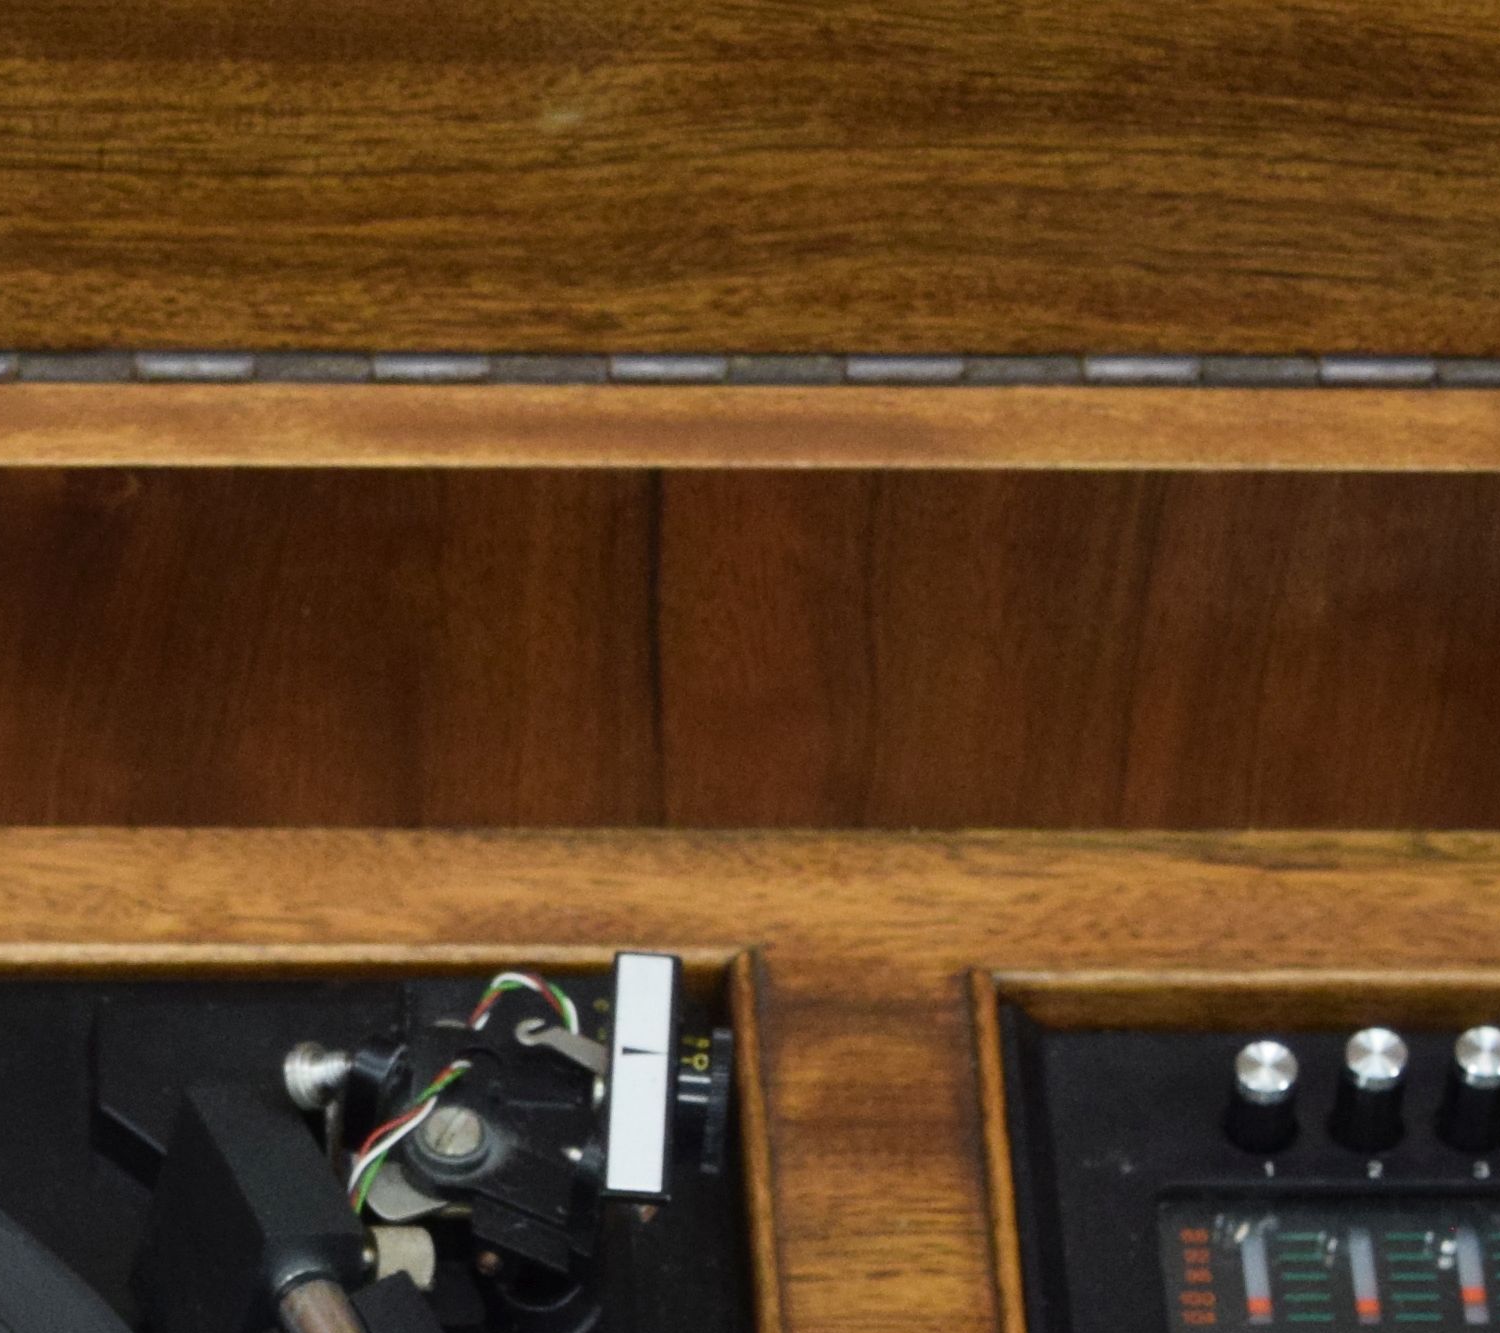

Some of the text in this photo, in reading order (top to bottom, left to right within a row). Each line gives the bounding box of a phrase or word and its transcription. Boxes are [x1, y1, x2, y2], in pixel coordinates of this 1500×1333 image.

[1265, 1162, 1274, 1177] 1
[1369, 1162, 1382, 1178] 2
[1475, 1162, 1490, 1179] 3
